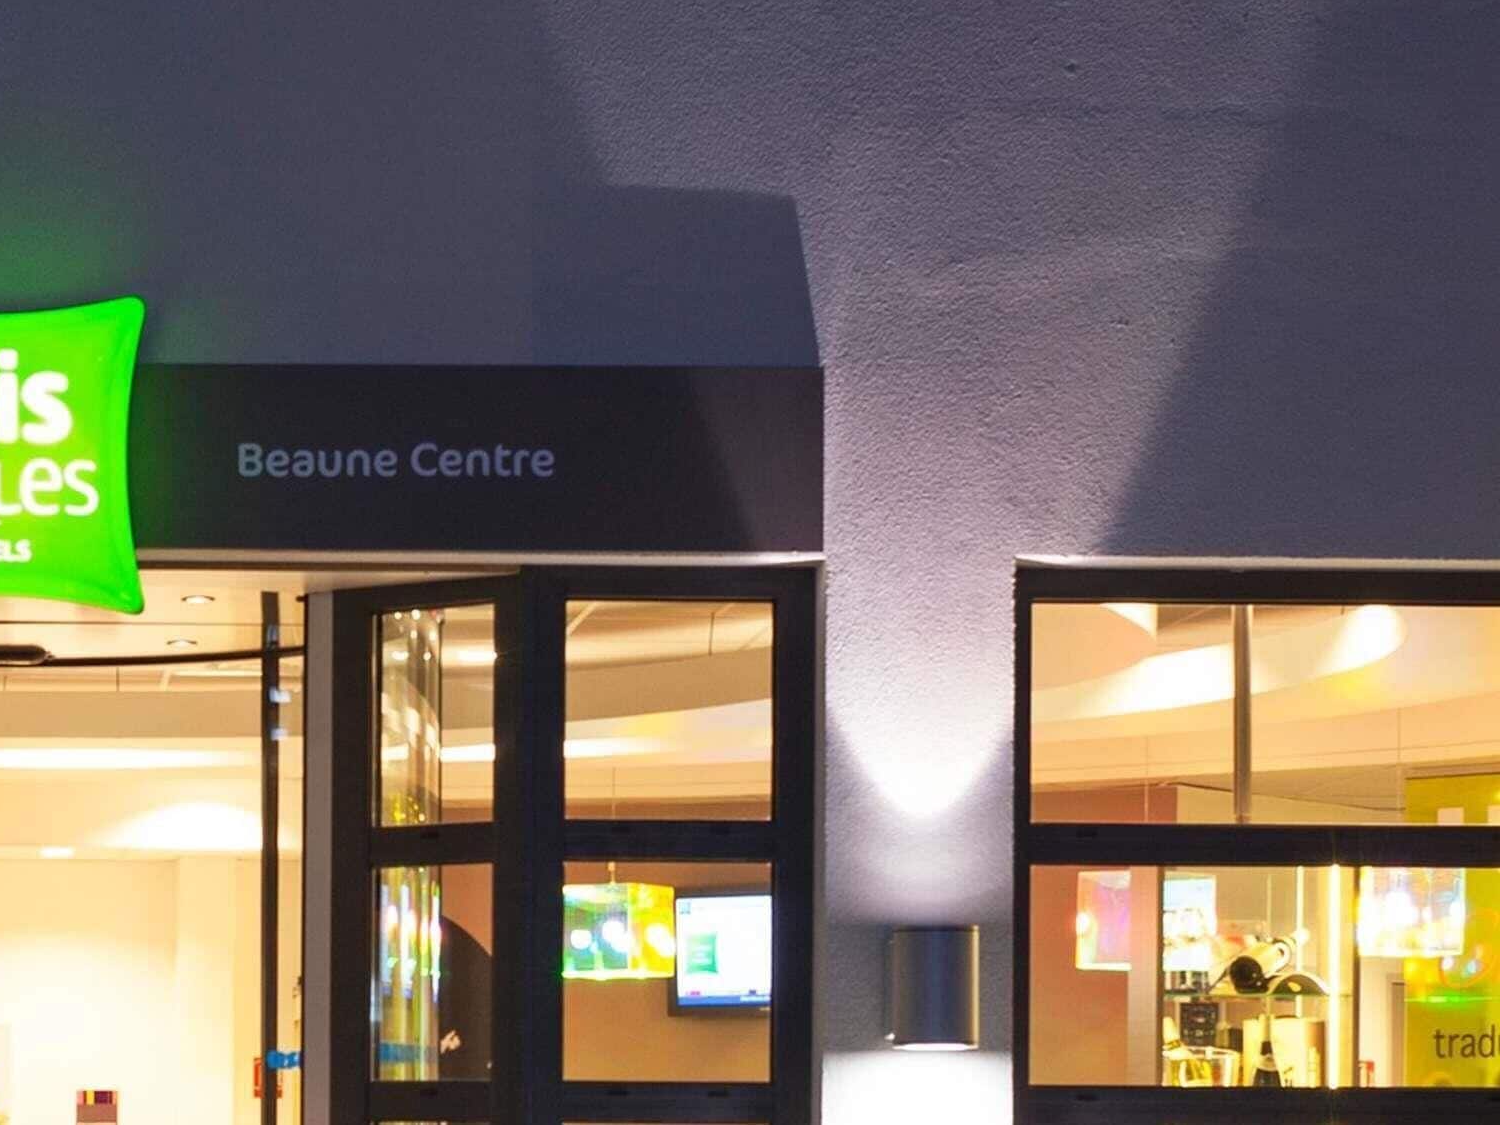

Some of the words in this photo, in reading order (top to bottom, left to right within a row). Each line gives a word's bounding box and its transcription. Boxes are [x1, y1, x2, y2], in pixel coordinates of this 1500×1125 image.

[237, 442, 398, 477] Beaune
[409, 442, 556, 477] Centre
[1433, 1023, 1500, 1059] trad
